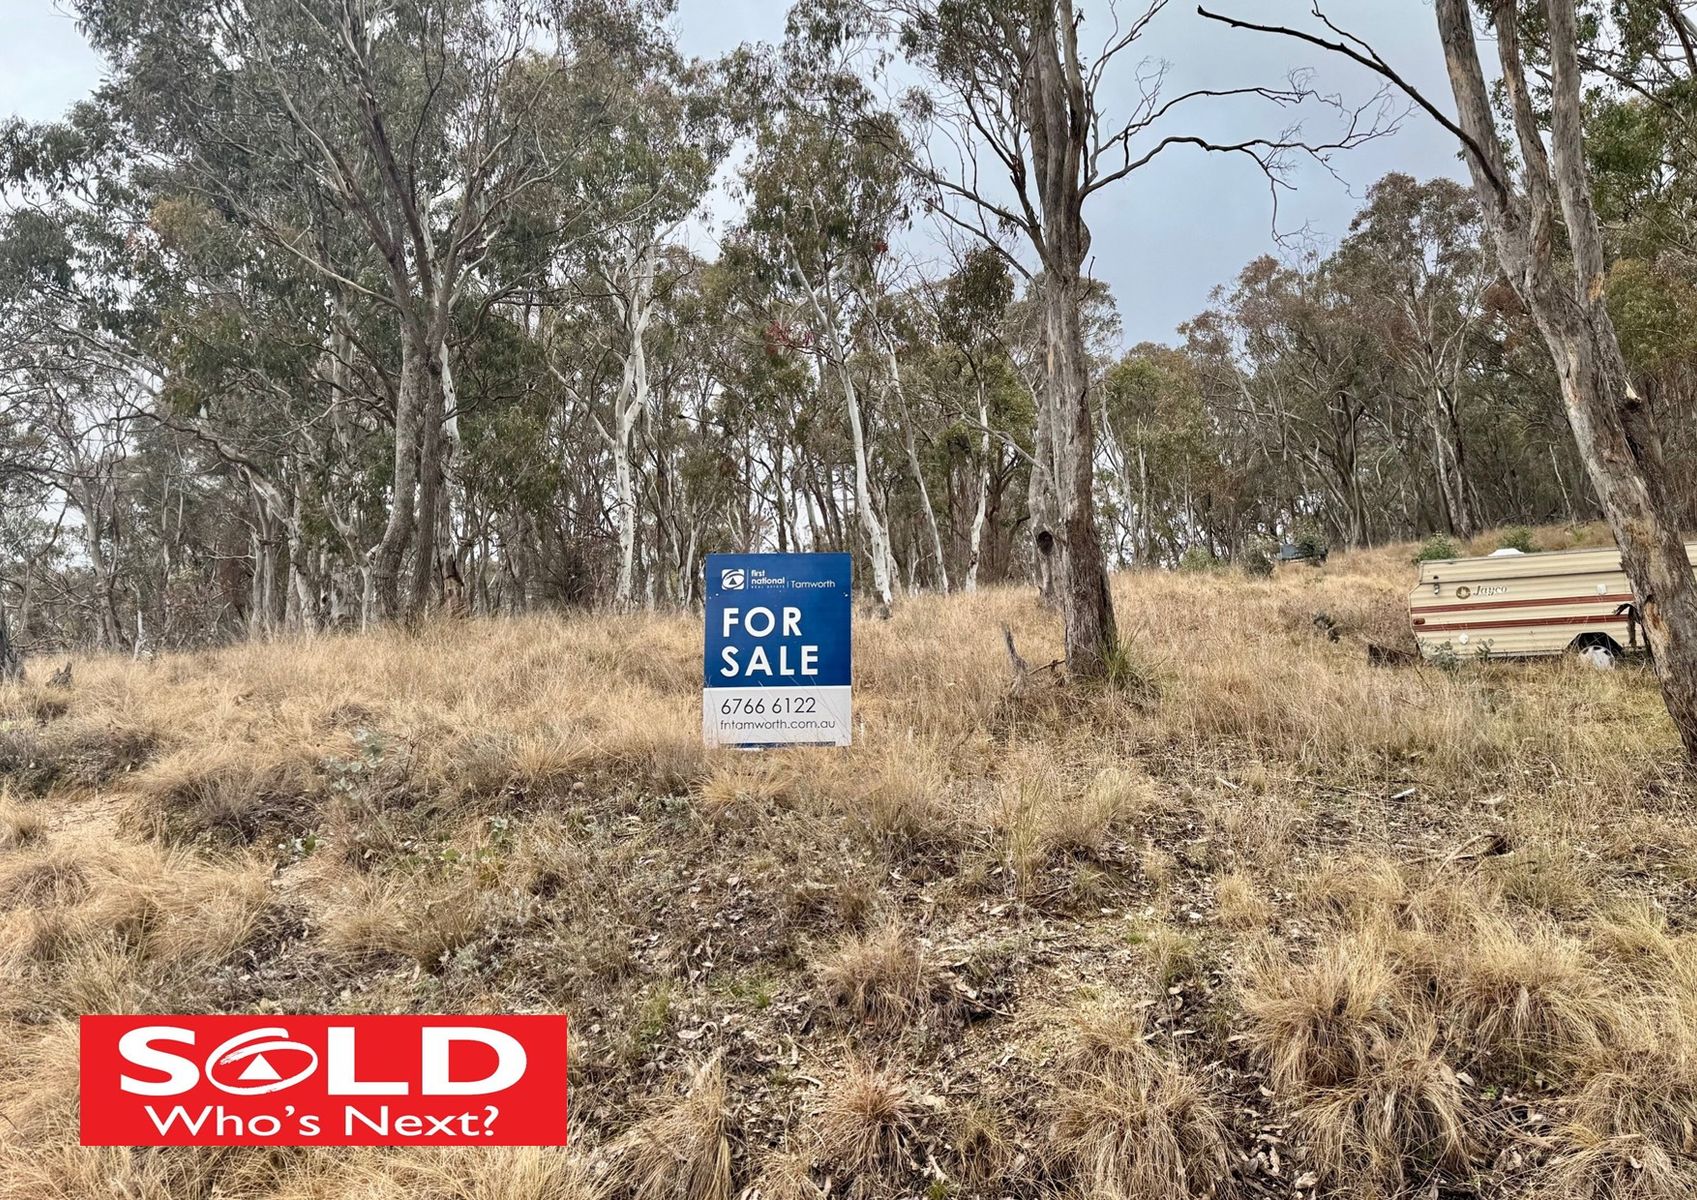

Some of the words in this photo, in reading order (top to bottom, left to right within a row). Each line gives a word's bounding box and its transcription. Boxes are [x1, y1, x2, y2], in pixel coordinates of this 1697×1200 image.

[791, 580, 836, 588] Tamworth
[1473, 585, 1508, 596] Jayco
[723, 607, 802, 638] FOR
[720, 645, 818, 677] SALE
[721, 698, 765, 714] 6766
[772, 697, 816, 713] 6122
[720, 719, 836, 730] fntamworth.com.au
